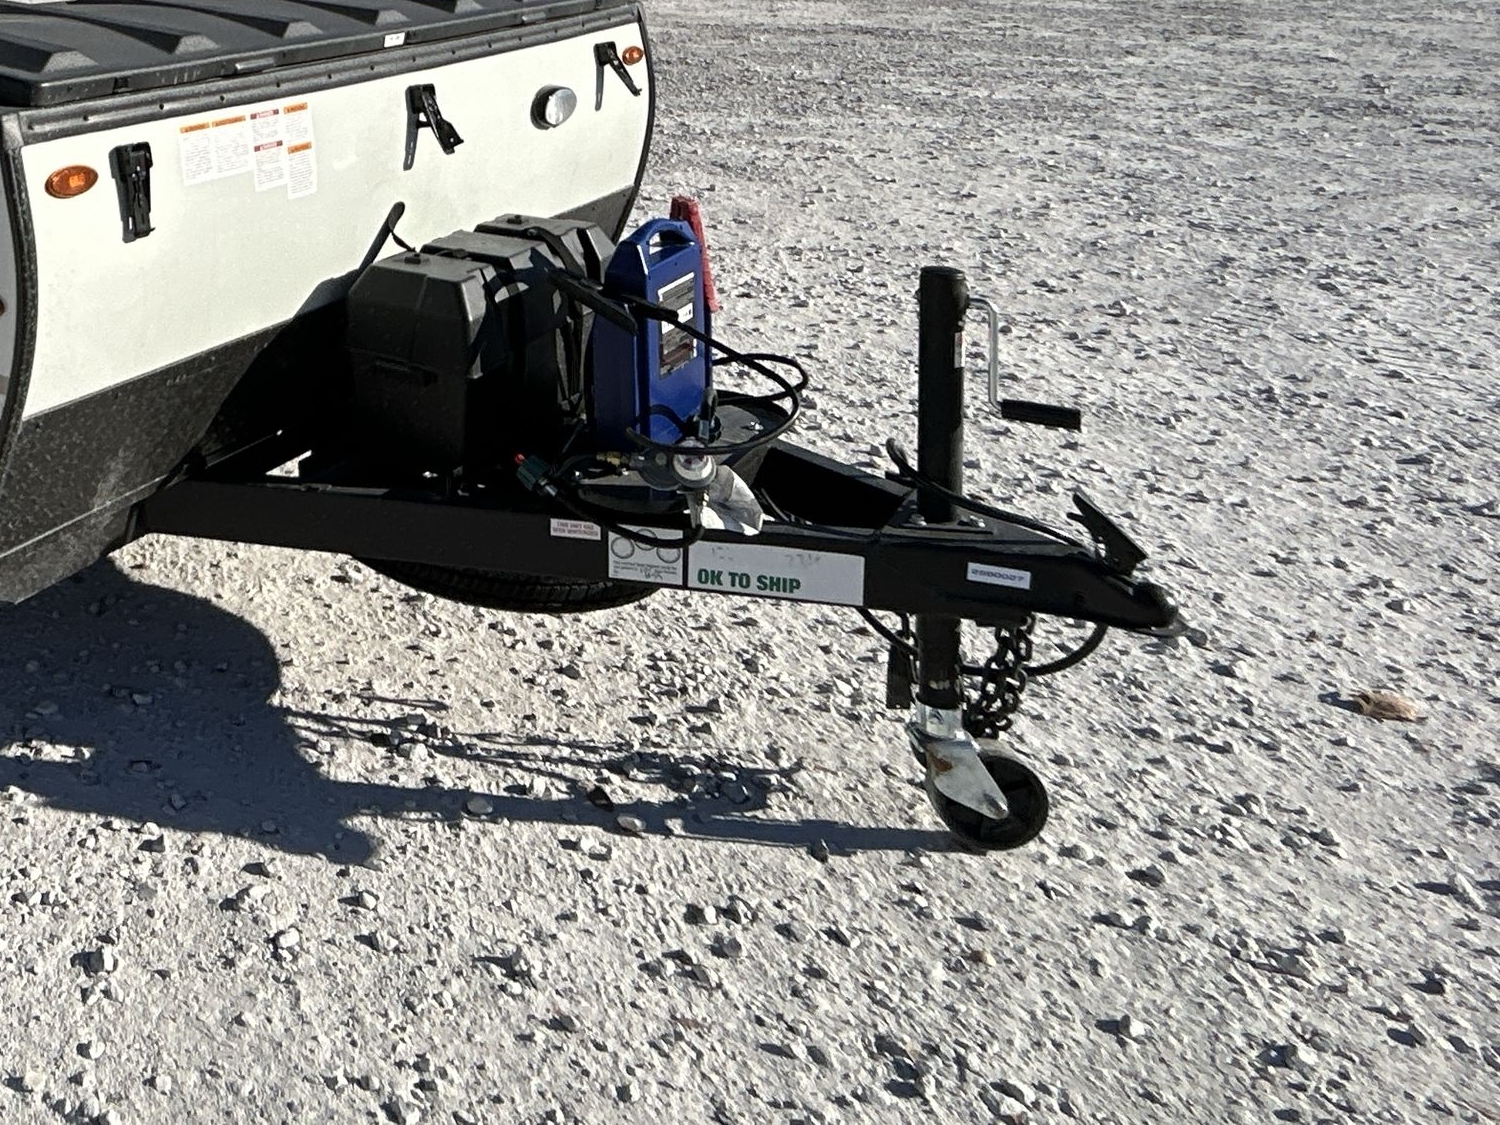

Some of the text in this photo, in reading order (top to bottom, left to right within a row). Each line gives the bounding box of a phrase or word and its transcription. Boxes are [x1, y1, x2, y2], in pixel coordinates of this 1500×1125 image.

[697, 568, 801, 594] OK TO SHIP
